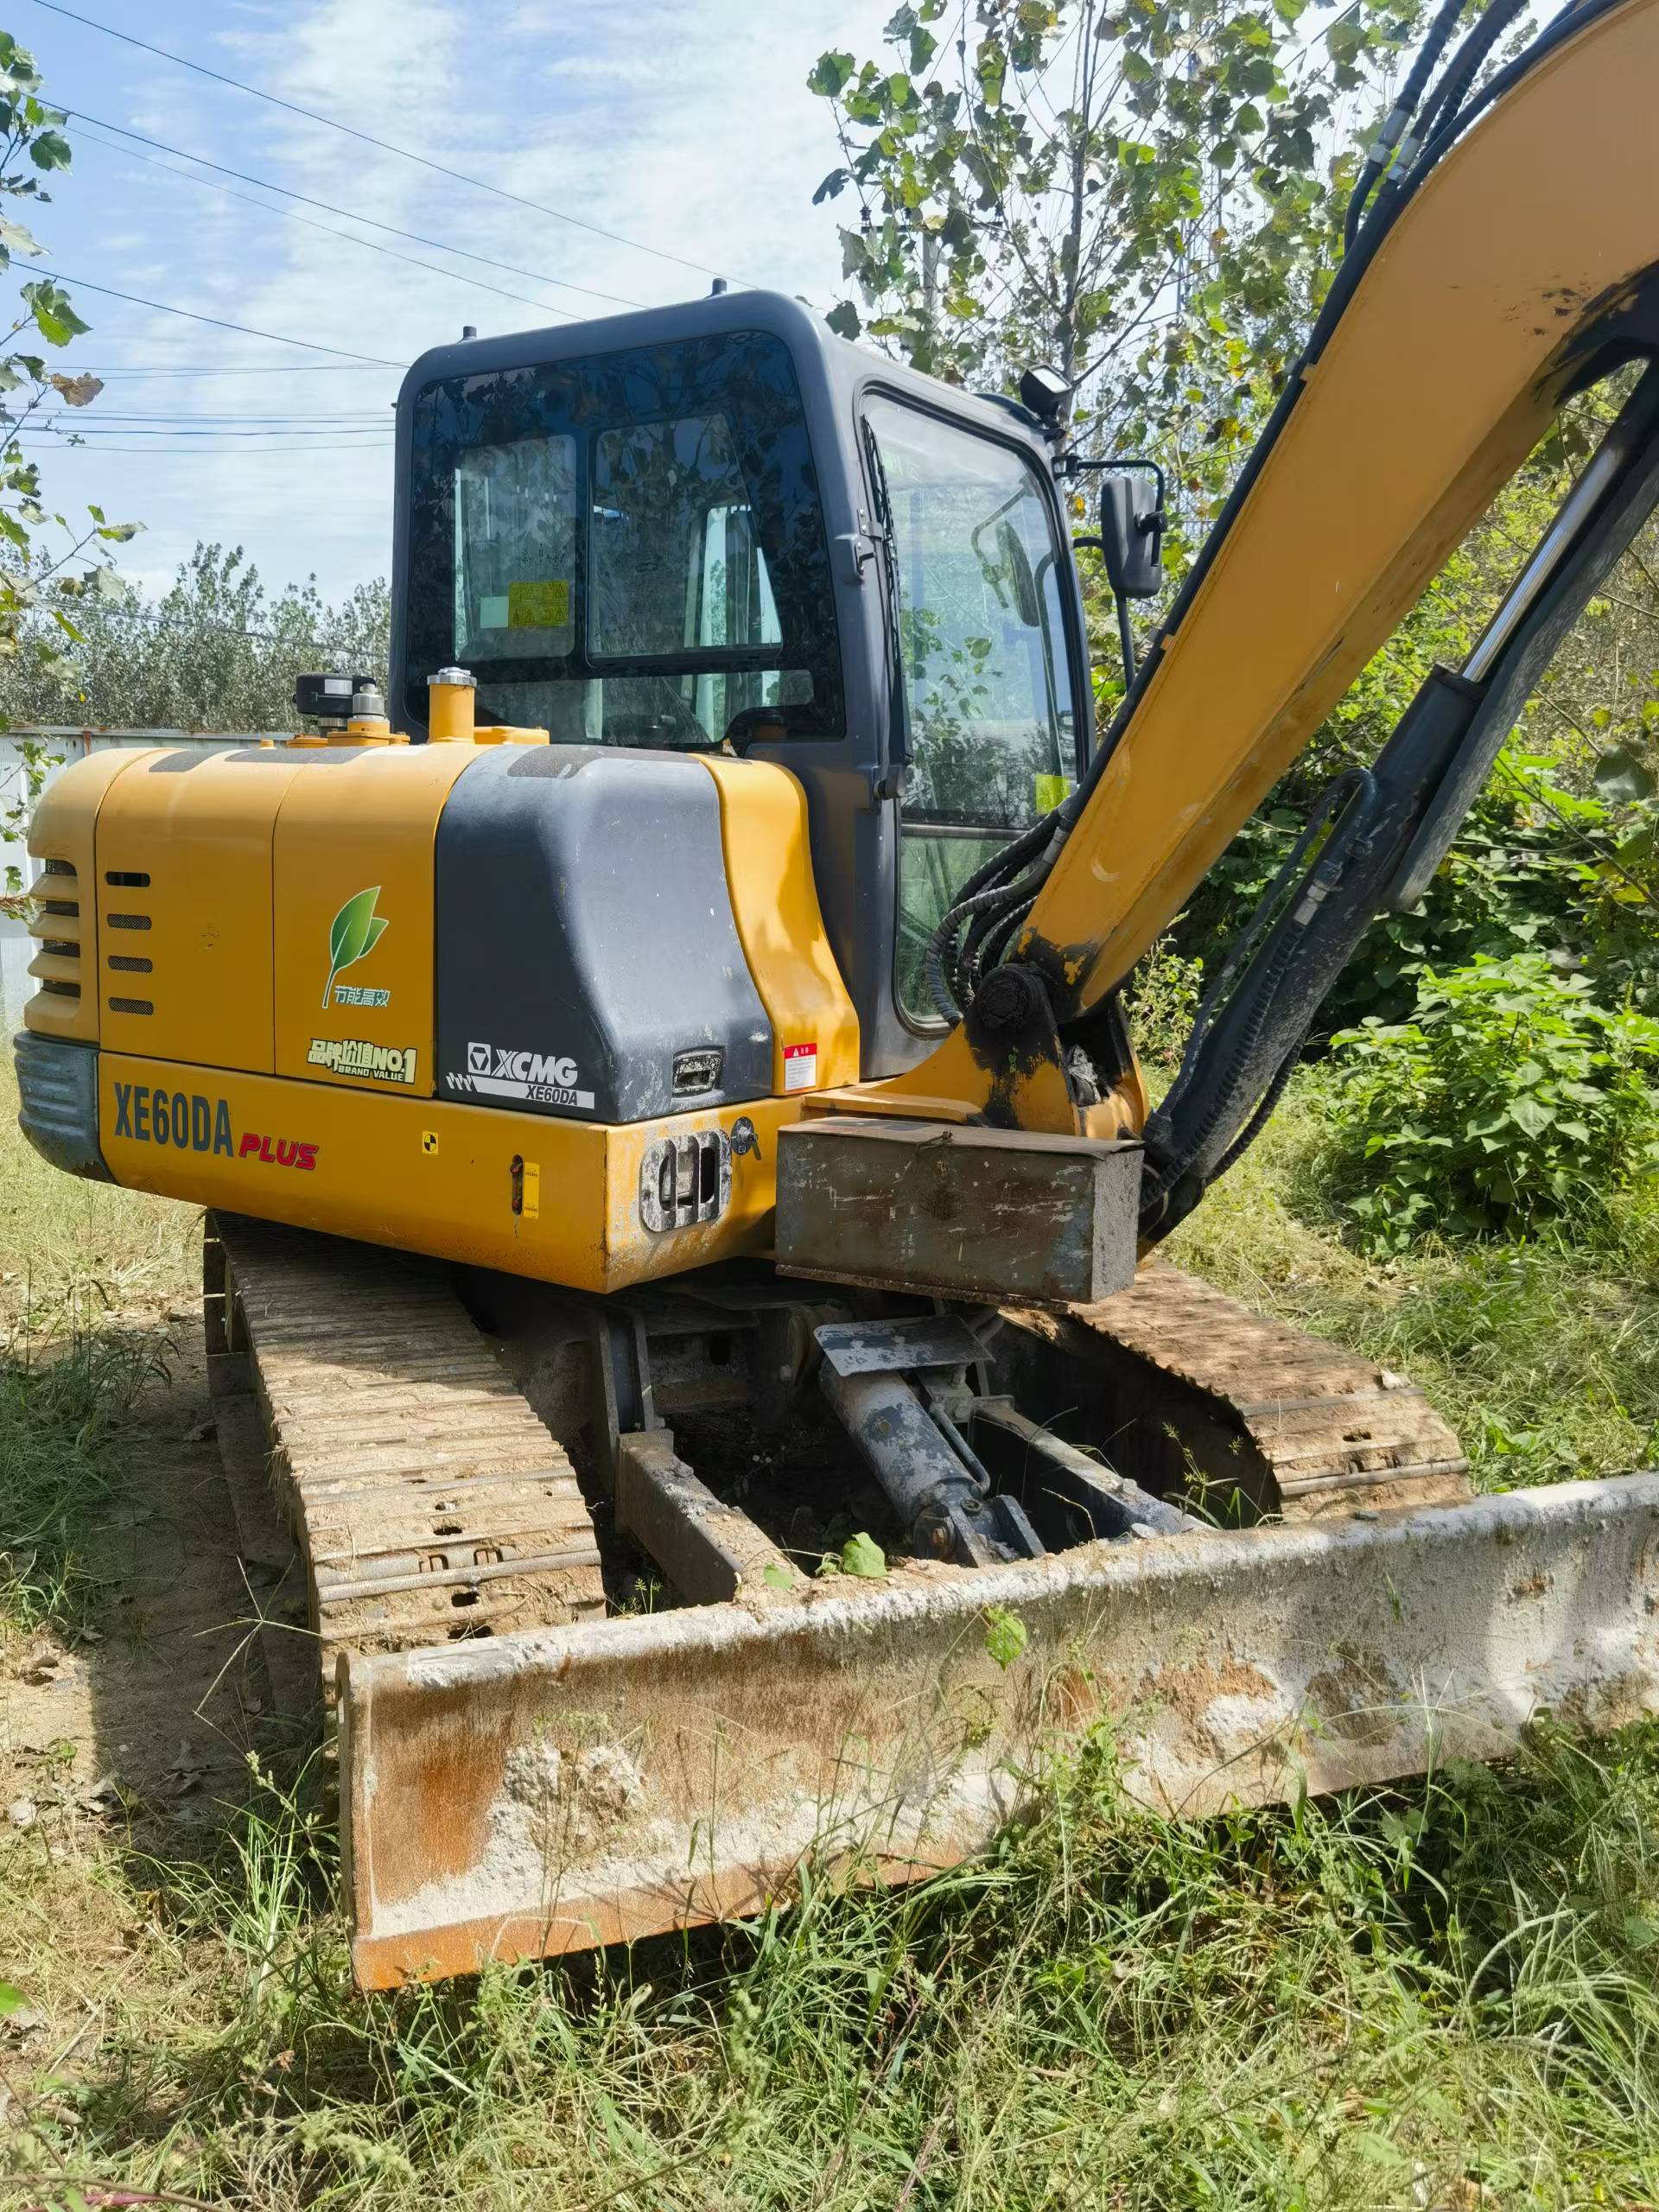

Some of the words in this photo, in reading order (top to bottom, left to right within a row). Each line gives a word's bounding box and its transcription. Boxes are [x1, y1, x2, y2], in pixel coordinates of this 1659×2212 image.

[334, 985, 391, 1007] 节能高效
[338, 1065, 370, 1077] BRAND
[373, 1070, 404, 1082] VALUE
[491, 1049, 578, 1087] XCMG
[525, 1084, 578, 1106] XE60DA
[114, 1082, 233, 1157] XE60DA
[238, 1133, 320, 1171] PLUS
